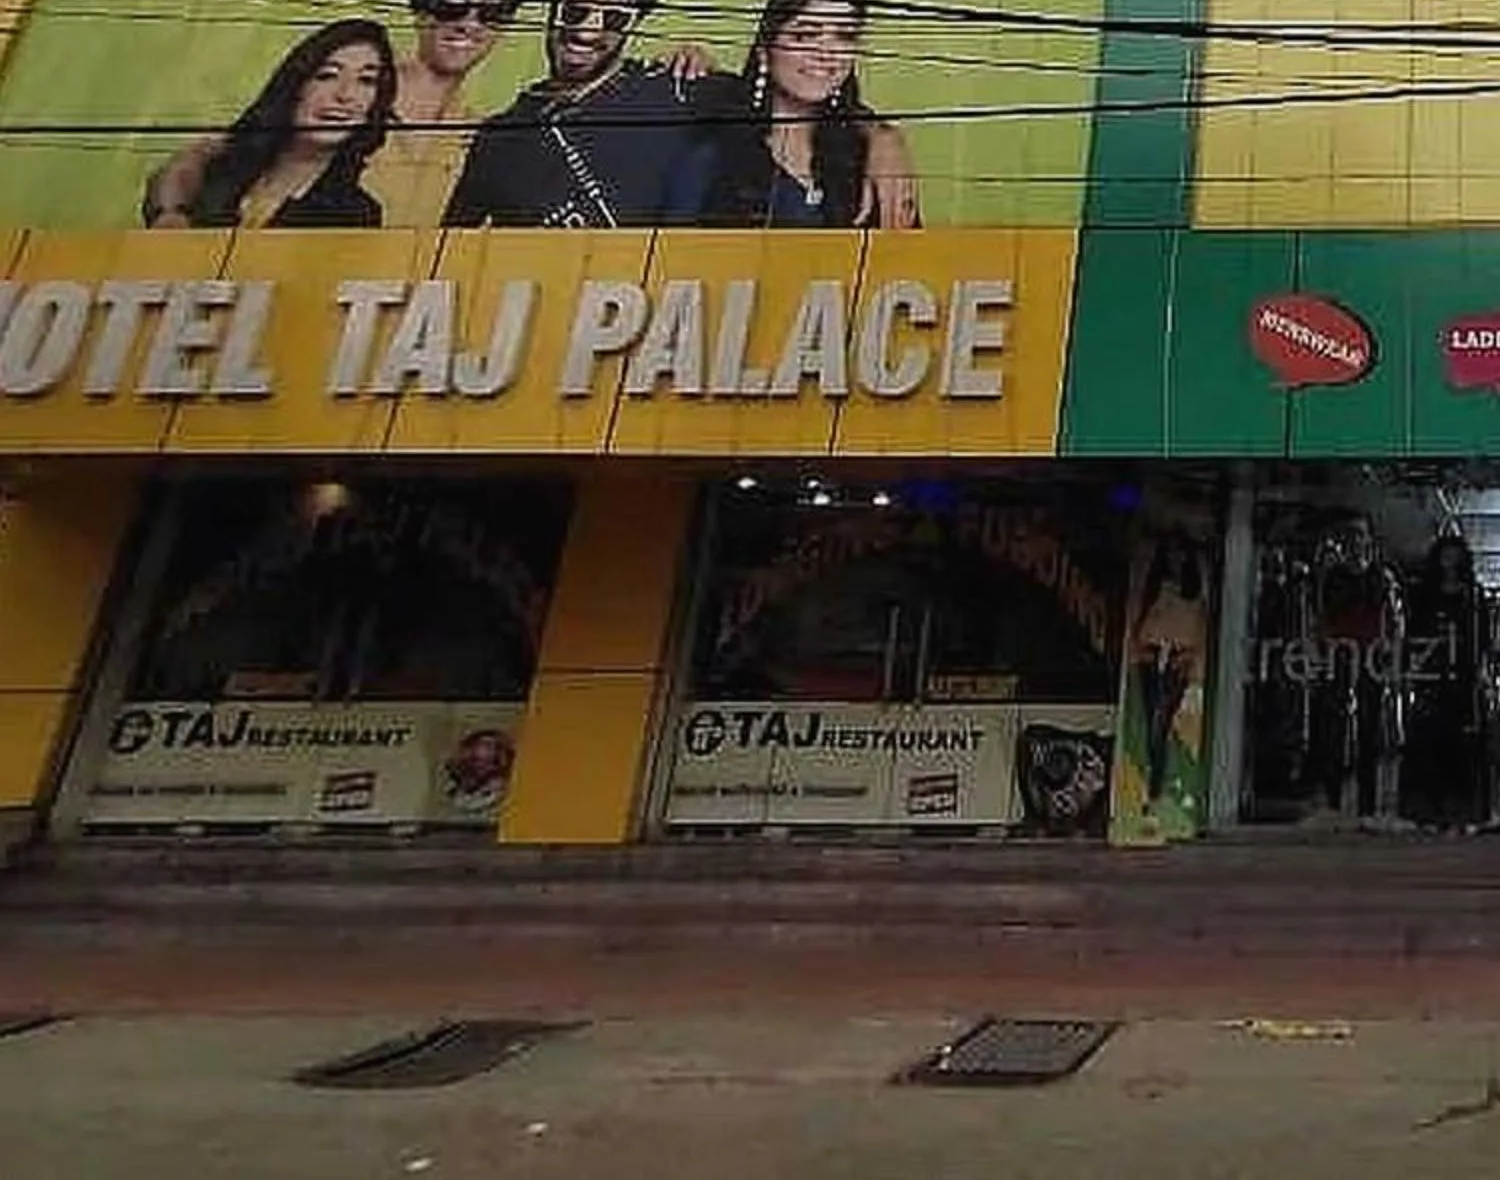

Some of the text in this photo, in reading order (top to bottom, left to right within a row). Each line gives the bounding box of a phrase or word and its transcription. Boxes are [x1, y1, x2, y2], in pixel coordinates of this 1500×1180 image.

[328, 279, 538, 398] TAJ
[561, 278, 1014, 399] PALACE
[161, 711, 252, 748] TAJ
[731, 711, 821, 748] TAJ
[821, 727, 985, 751] RESTAURANT
